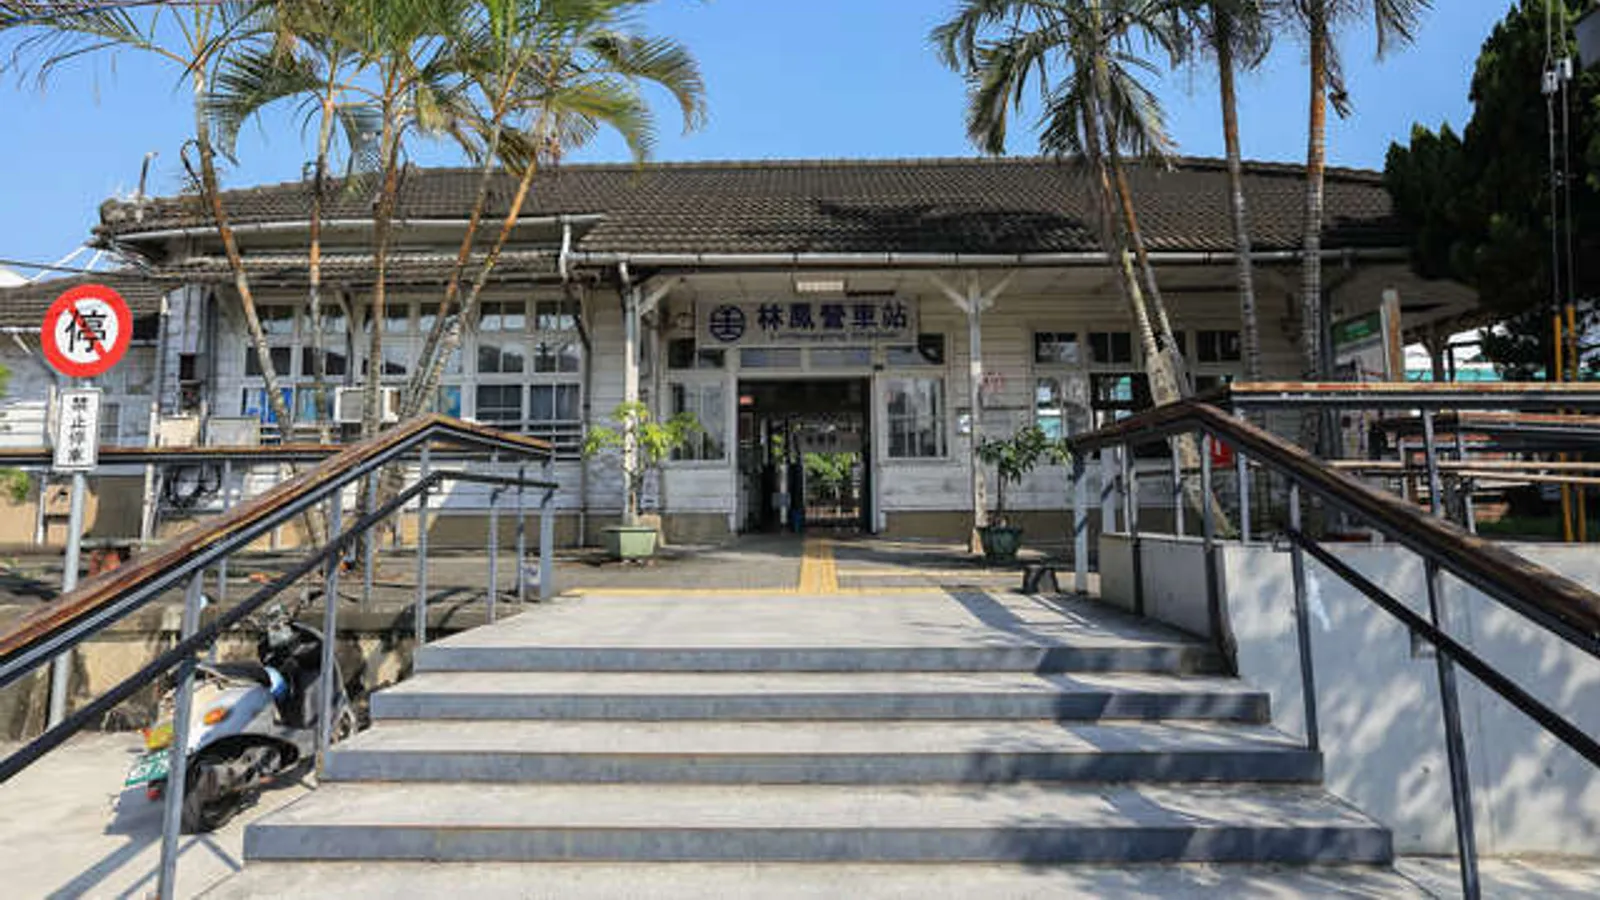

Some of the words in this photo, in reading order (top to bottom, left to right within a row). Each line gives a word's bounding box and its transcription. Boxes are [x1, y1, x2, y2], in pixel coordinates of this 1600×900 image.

[65, 309, 107, 353] 停
[757, 301, 907, 331] 林鳳營車站
